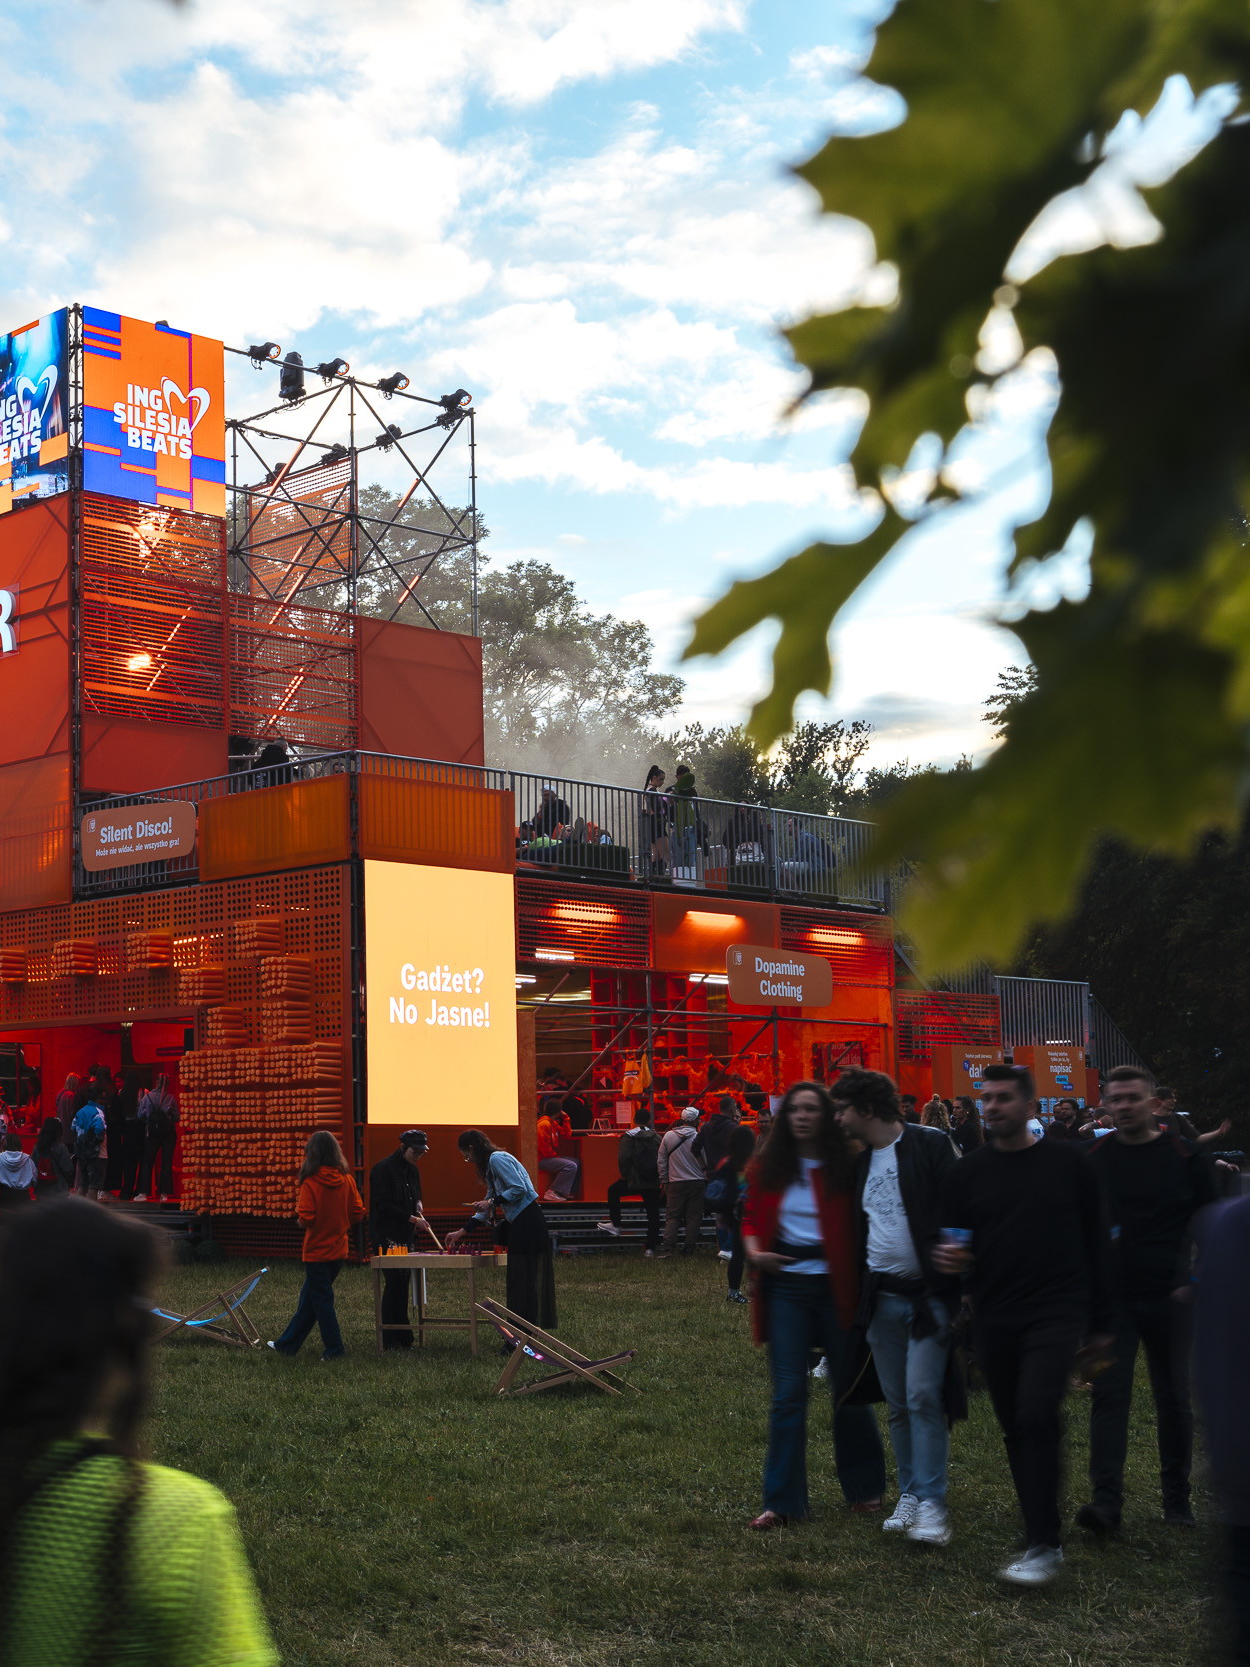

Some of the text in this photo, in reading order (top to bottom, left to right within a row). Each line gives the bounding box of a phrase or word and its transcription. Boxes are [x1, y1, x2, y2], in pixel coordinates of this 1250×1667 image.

[127, 383, 163, 411] ING
[113, 401, 192, 439] SILESIA
[127, 426, 193, 460] BEATS
[99, 816, 173, 844] Silent Disco!
[400, 962, 485, 994] Gadżet?
[755, 957, 805, 978] Dopamine
[759, 979, 803, 1002] Clothing
[389, 996, 490, 1028] No Jasne!
[1050, 1063, 1072, 1075] napisać
